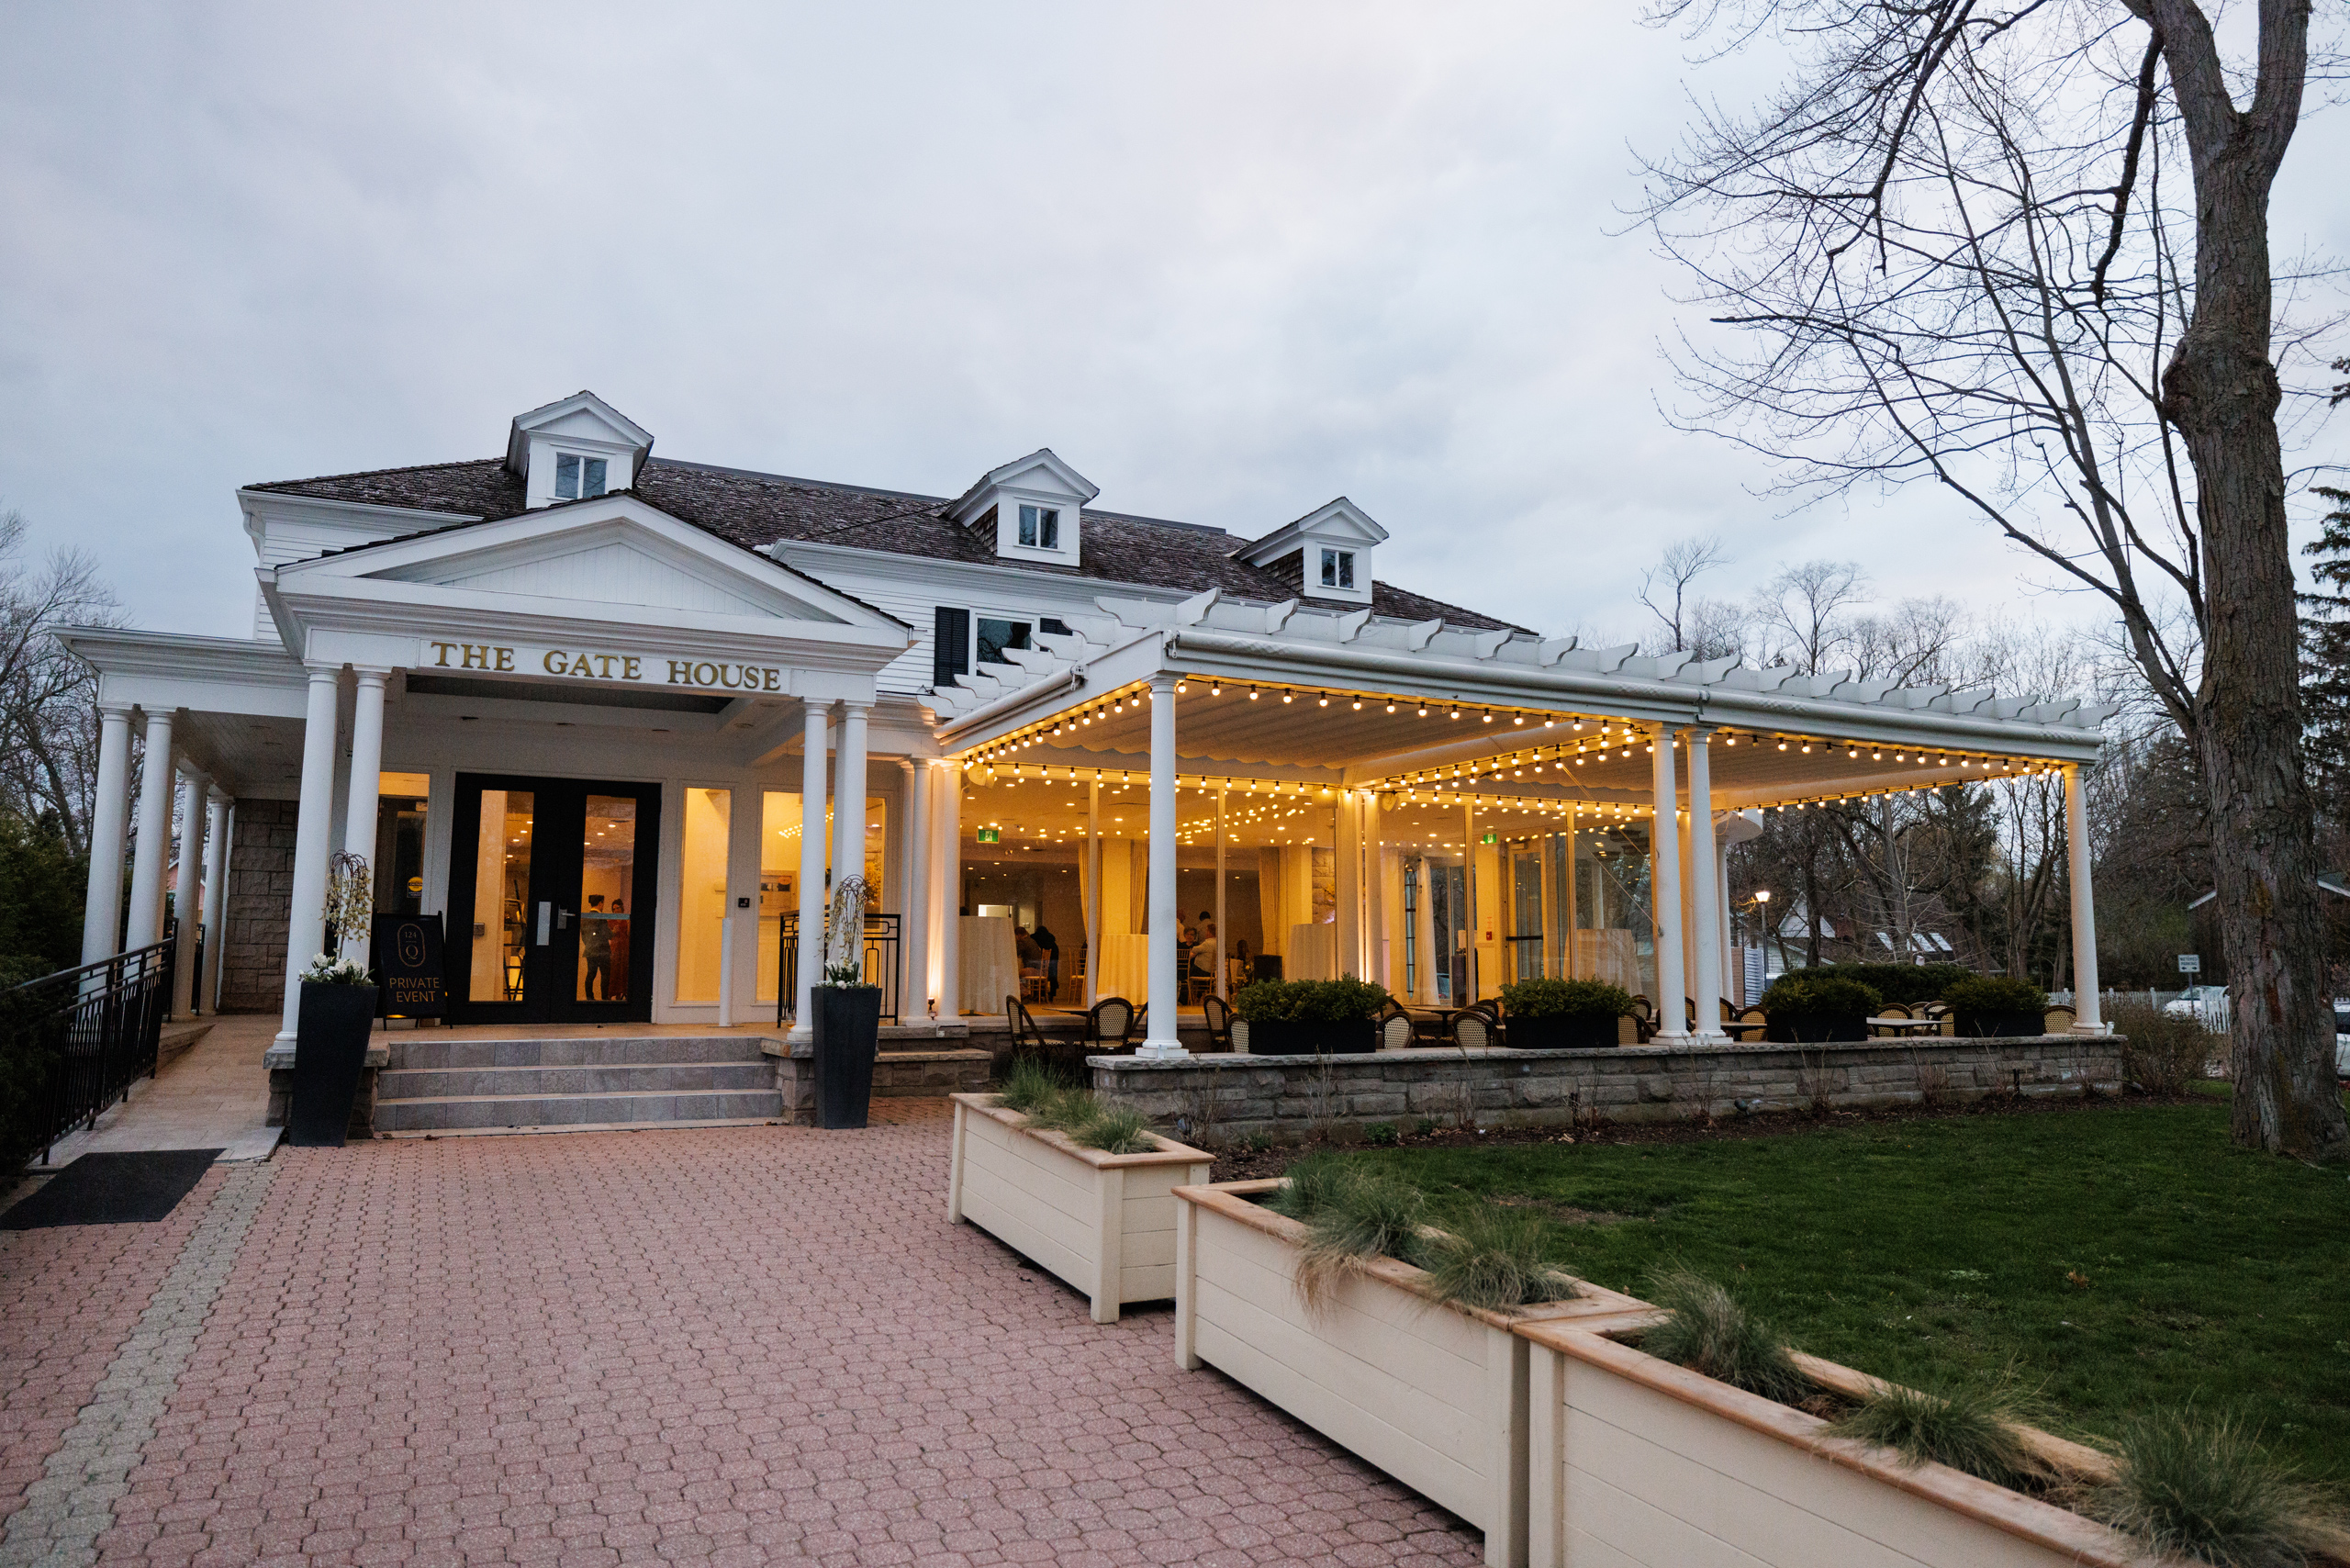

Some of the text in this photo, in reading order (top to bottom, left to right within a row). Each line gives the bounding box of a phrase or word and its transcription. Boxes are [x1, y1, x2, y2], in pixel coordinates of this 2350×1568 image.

[431, 642, 781, 690] THE GATE HOUSE
[405, 945, 419, 960] Q
[389, 977, 440, 989] PRIVATE
[396, 991, 436, 1002] EVENT
